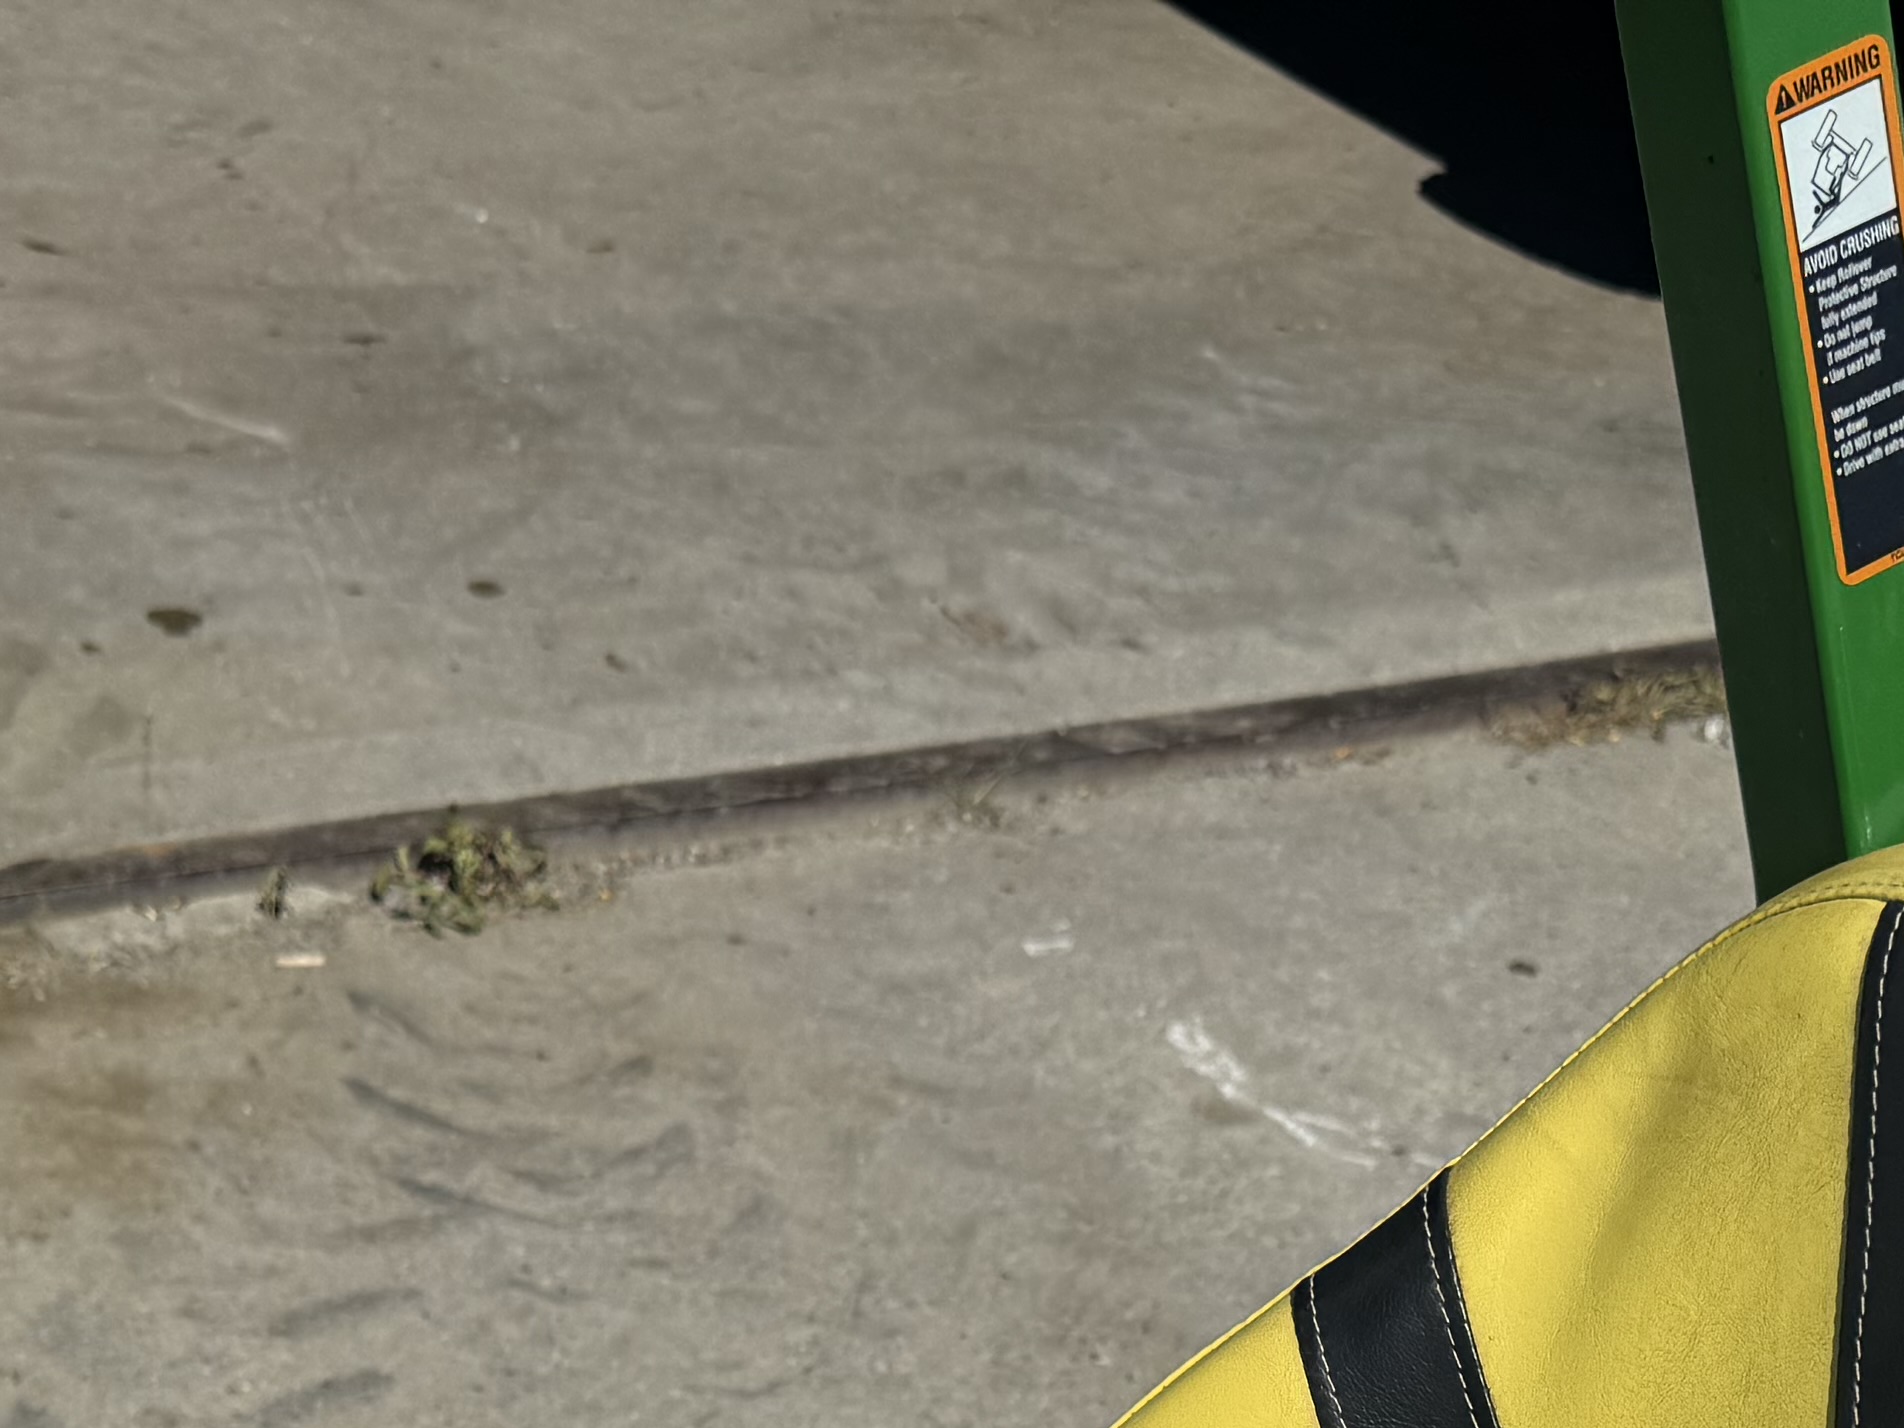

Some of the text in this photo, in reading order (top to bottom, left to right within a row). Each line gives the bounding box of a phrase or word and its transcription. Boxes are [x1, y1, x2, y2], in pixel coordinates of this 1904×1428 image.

[1793, 44, 1881, 103] WARNING
[1804, 215, 1900, 278] AVOID CRUSHING
[1854, 430, 1872, 451] NOT
